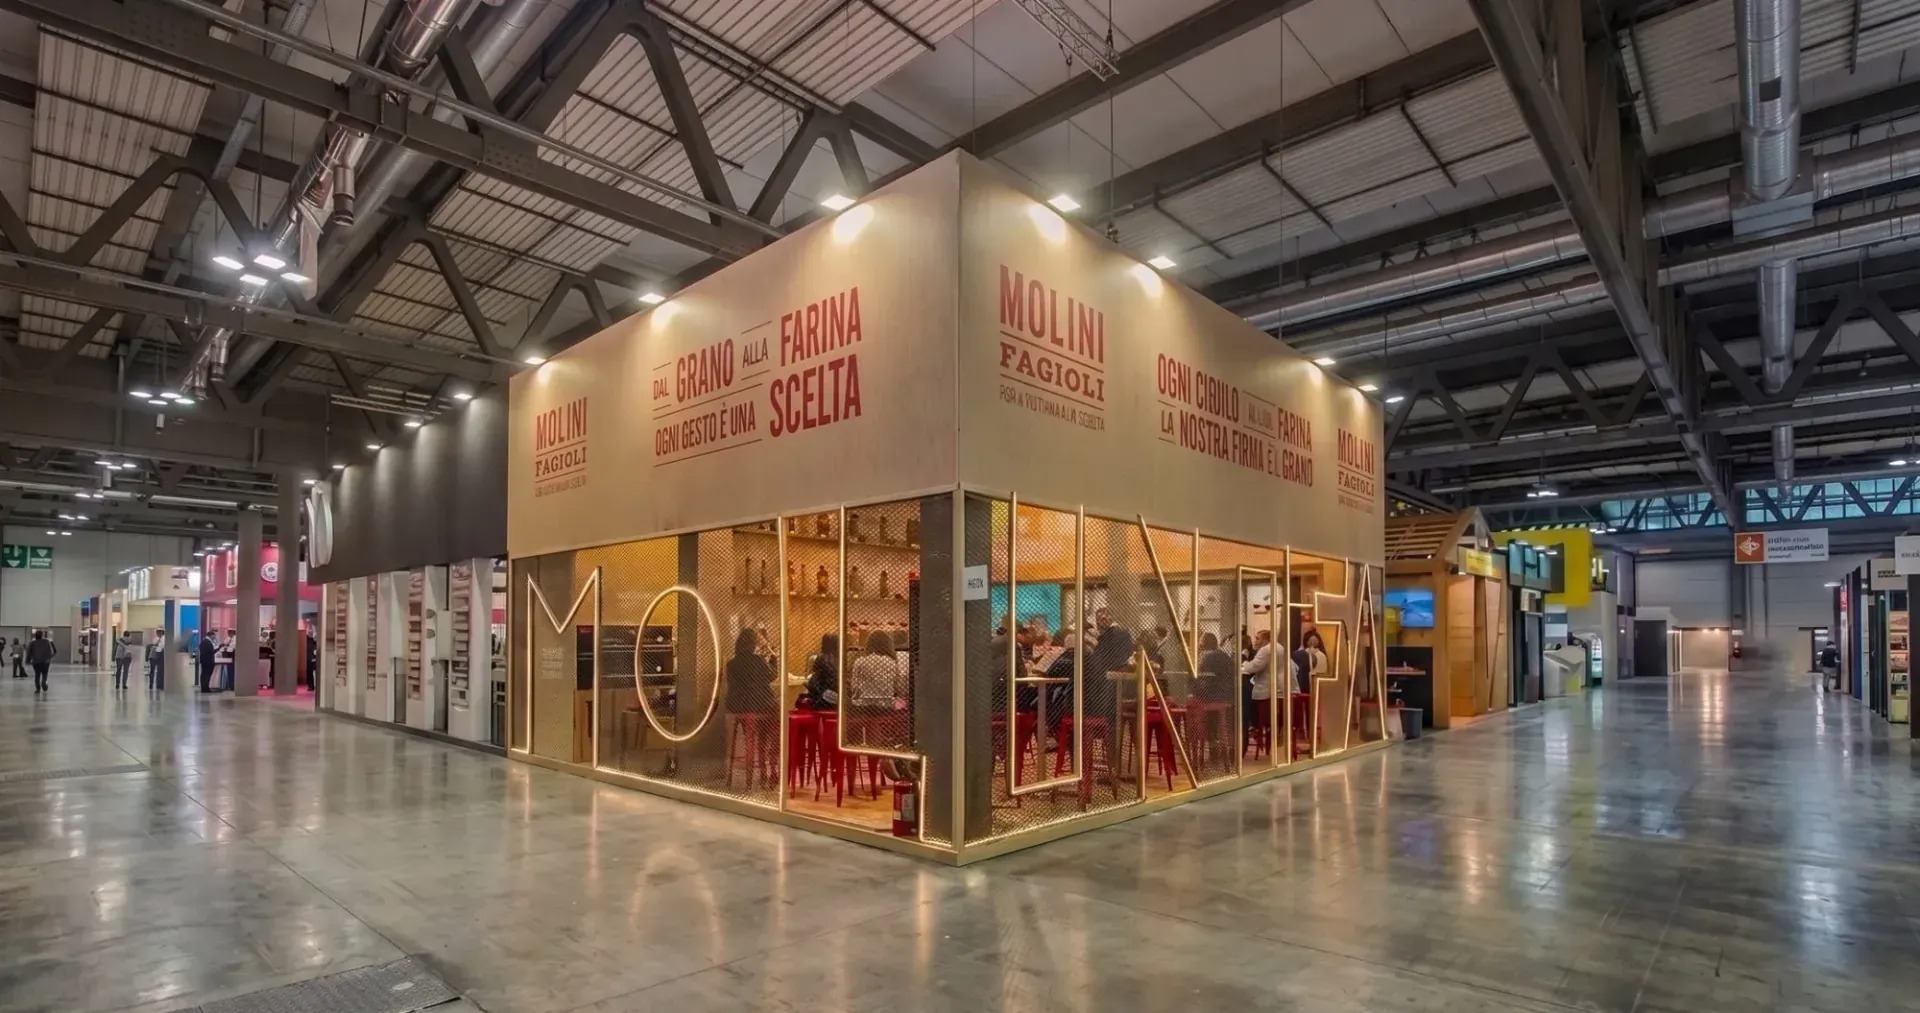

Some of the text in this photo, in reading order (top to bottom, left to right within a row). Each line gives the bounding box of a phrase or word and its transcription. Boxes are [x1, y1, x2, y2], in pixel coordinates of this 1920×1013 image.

[653, 287, 862, 403] DAL GRANO ALLA FARINA
[1000, 264, 1104, 364] MOLINI
[655, 353, 862, 457] OGNI GESTO È UNA SCELTA
[1000, 341, 1104, 403] FAGIOLI
[1158, 353, 1191, 404] OGNI
[1278, 408, 1313, 453] FARINA
[536, 396, 588, 451] MOLINI
[1161, 410, 1175, 436] LA
[1180, 410, 1229, 461] NOSTRA
[1232, 430, 1264, 472] FIRMA
[1283, 449, 1313, 487] GRANO
[1338, 428, 1374, 475] MOLINI
[535, 446, 587, 477] FAGIOLI
[1338, 471, 1374, 497] FAGIOLI
